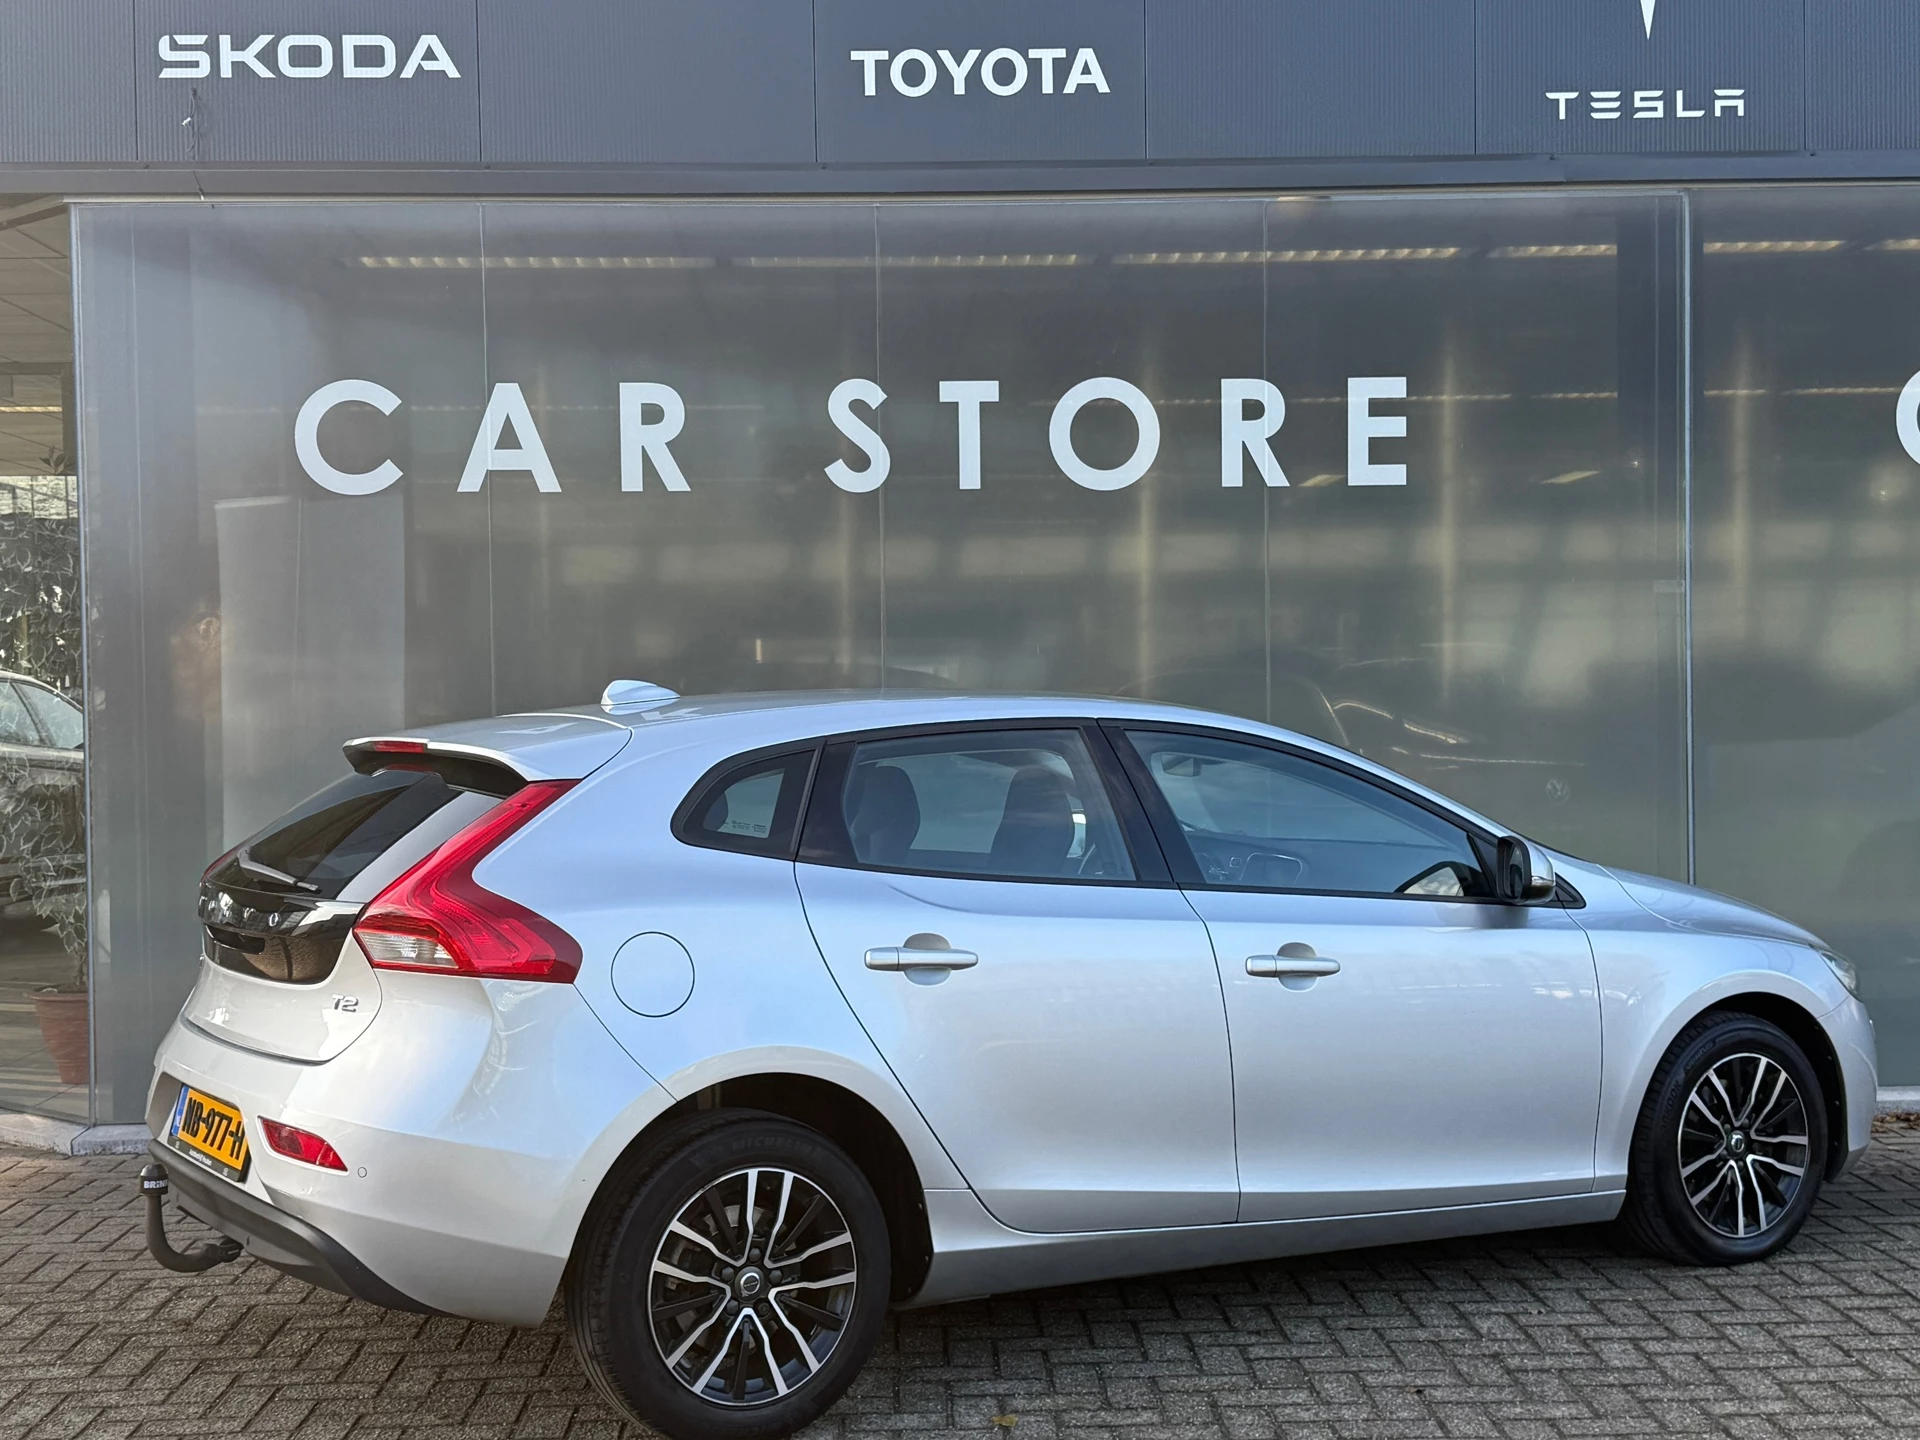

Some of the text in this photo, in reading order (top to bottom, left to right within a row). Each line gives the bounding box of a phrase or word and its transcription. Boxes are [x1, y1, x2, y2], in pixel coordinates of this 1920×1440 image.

[158, 34, 462, 79] SKODA
[850, 47, 1111, 97] TOYOTA
[1545, 89, 1745, 120] TESLA
[294, 376, 1408, 496] CAR STORE
[331, 993, 359, 1013] T2
[182, 1097, 246, 1161] NB-977-H
